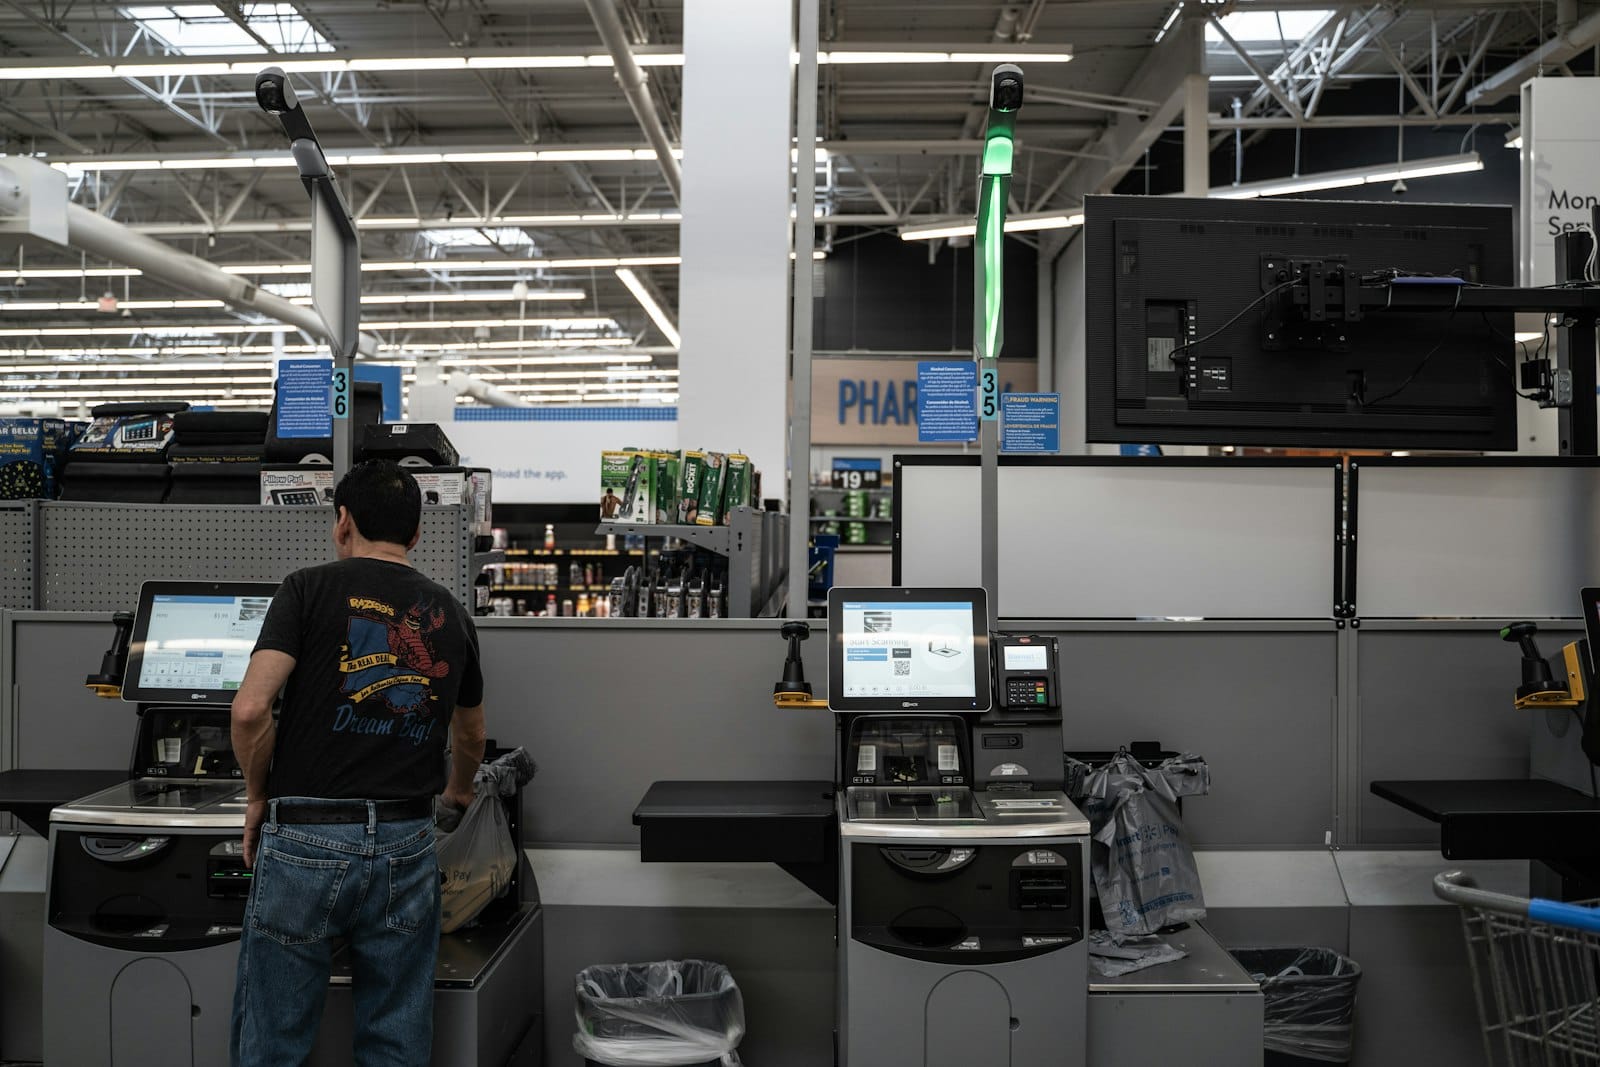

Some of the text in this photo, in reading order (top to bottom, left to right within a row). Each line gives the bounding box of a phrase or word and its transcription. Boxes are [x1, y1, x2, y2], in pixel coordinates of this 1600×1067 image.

[1548, 189, 1600, 209] Mon
[1548, 215, 1591, 236] Ser
[838, 379, 918, 425] PHAR
[11, 427, 39, 436] BELLY
[262, 474, 287, 485] Pillow
[287, 475, 304, 485] Pad
[523, 468, 541, 478] the
[686, 463, 697, 494] ROCKET
[870, 637, 910, 648] Scanning
[346, 654, 391, 672] The REAL DEAL
[332, 704, 438, 745] Dream Big!
[453, 870, 472, 882] Pay
